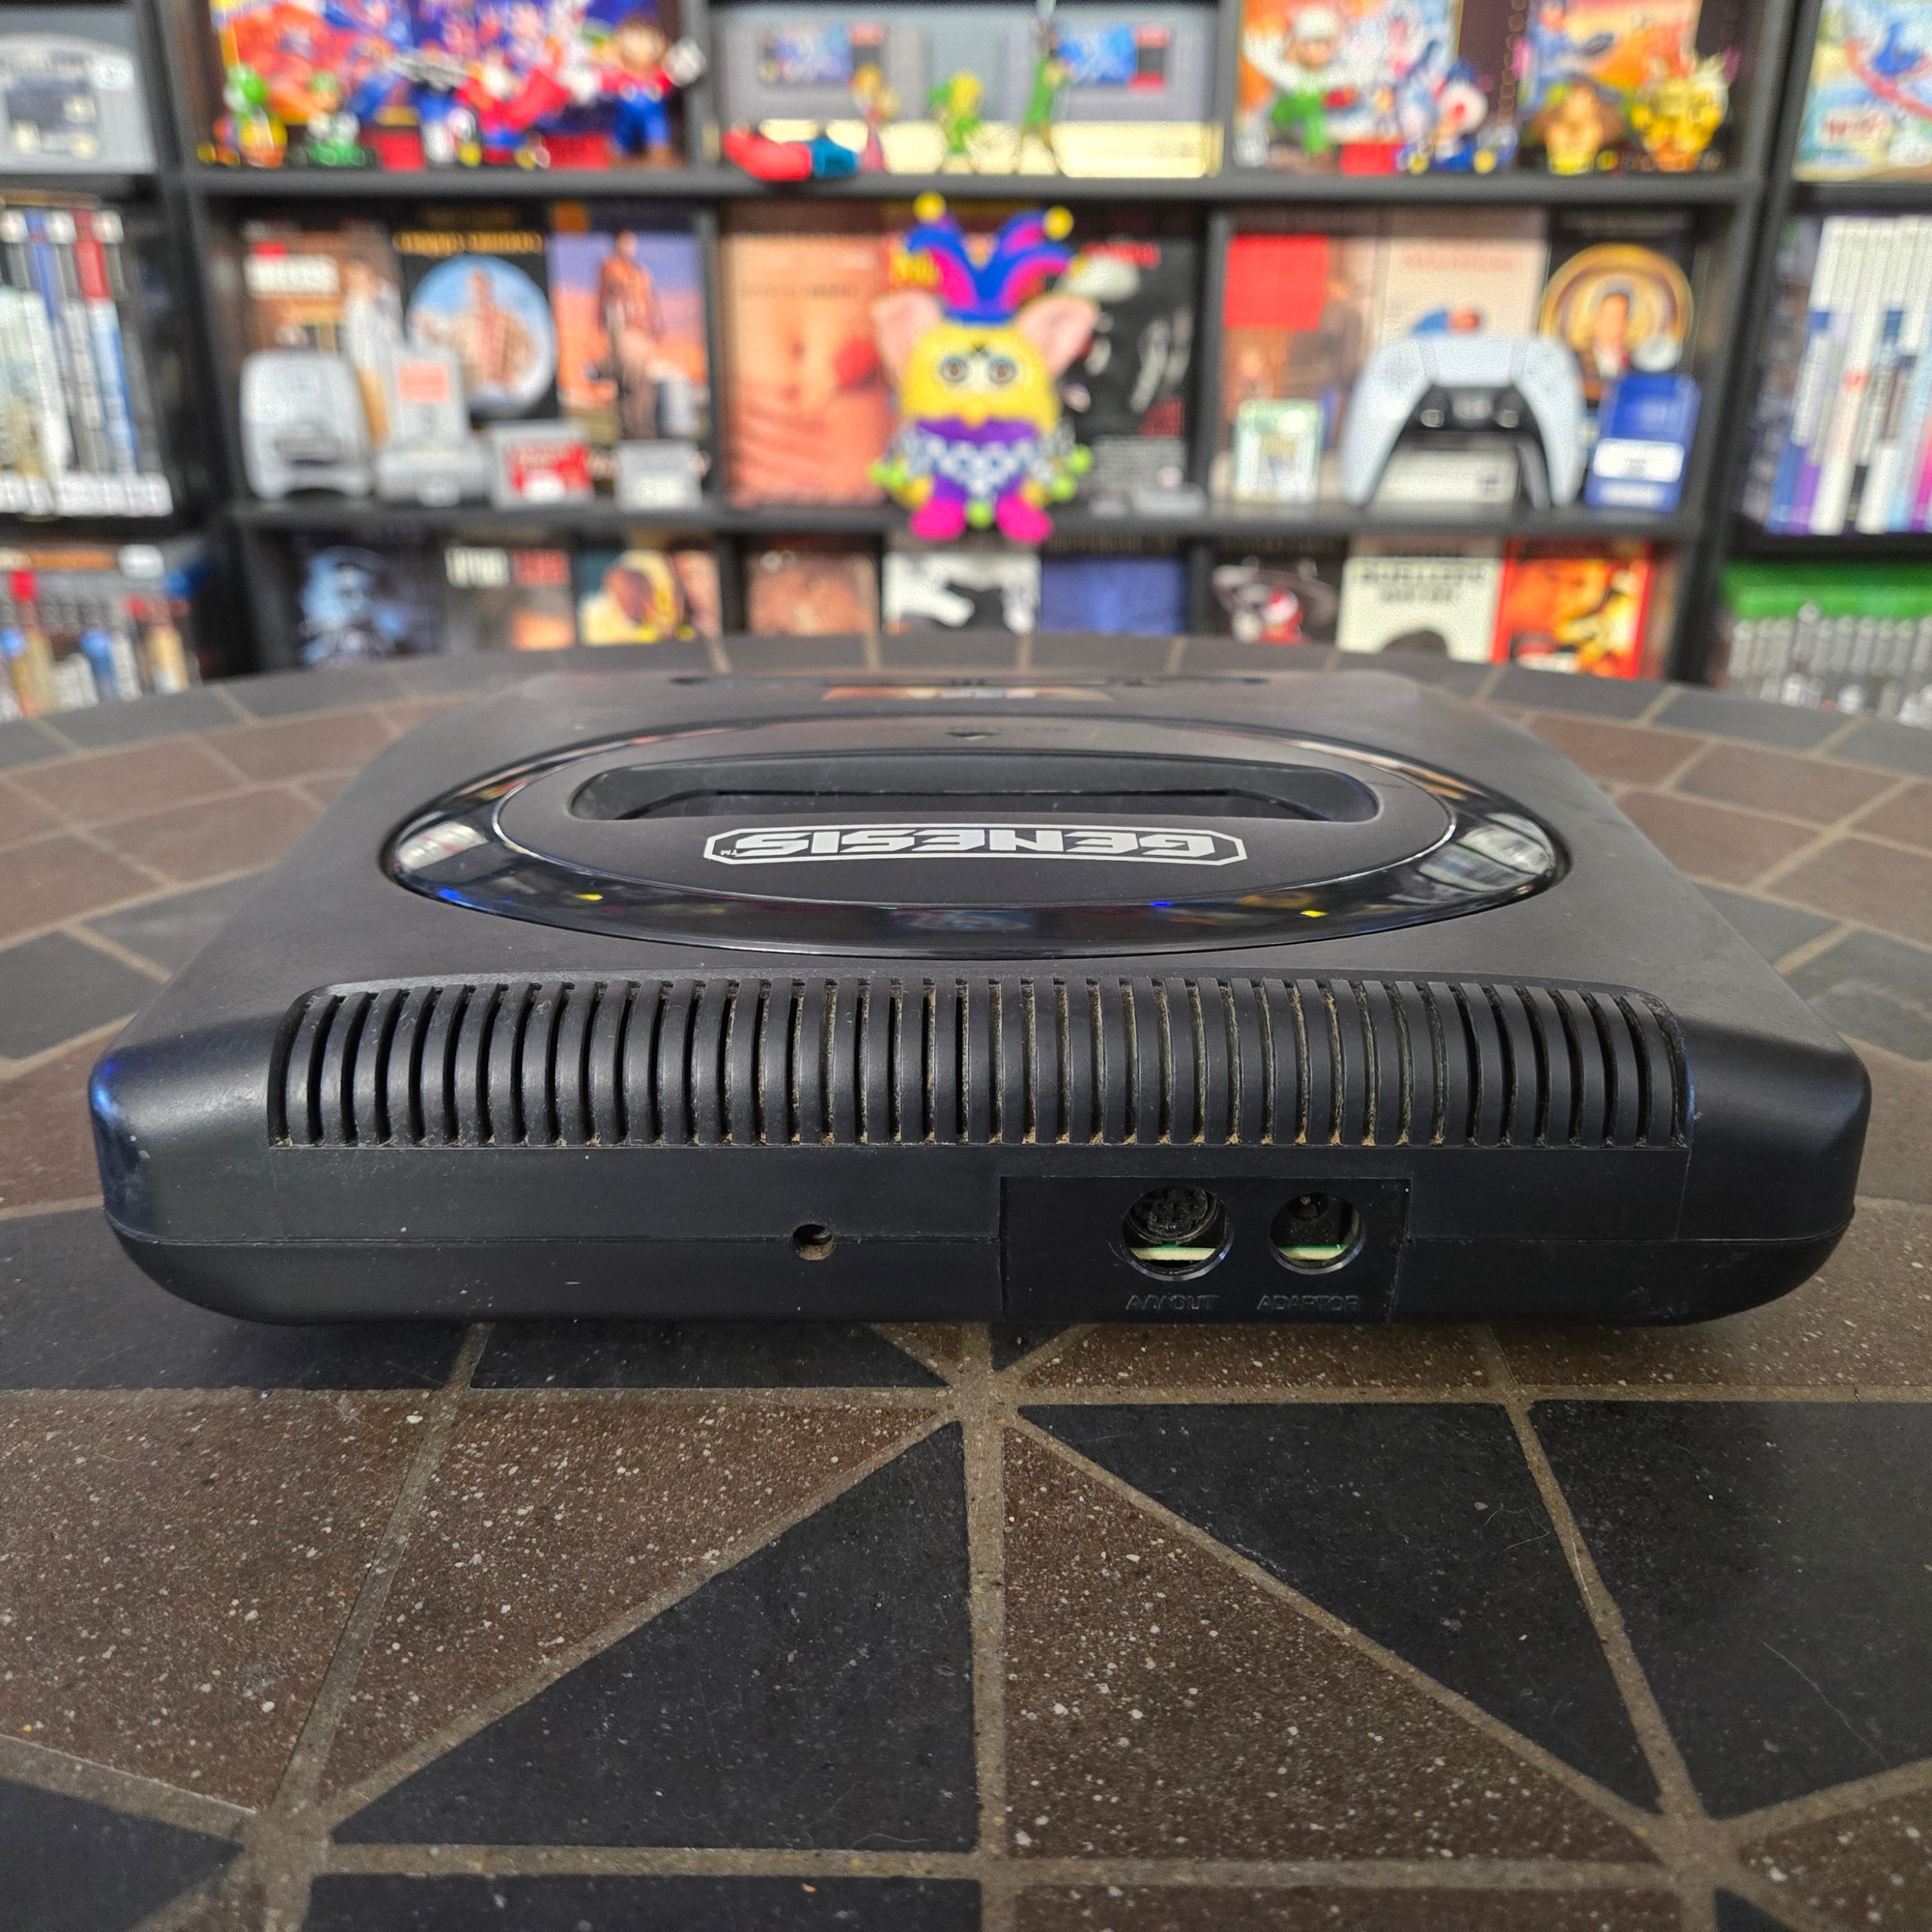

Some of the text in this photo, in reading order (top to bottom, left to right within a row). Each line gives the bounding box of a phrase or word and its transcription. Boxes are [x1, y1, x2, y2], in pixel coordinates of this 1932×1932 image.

[735, 829, 1215, 858] GENESIS
[1169, 1293, 1220, 1311] OUT
[1256, 1293, 1361, 1311] ADAPTOR
